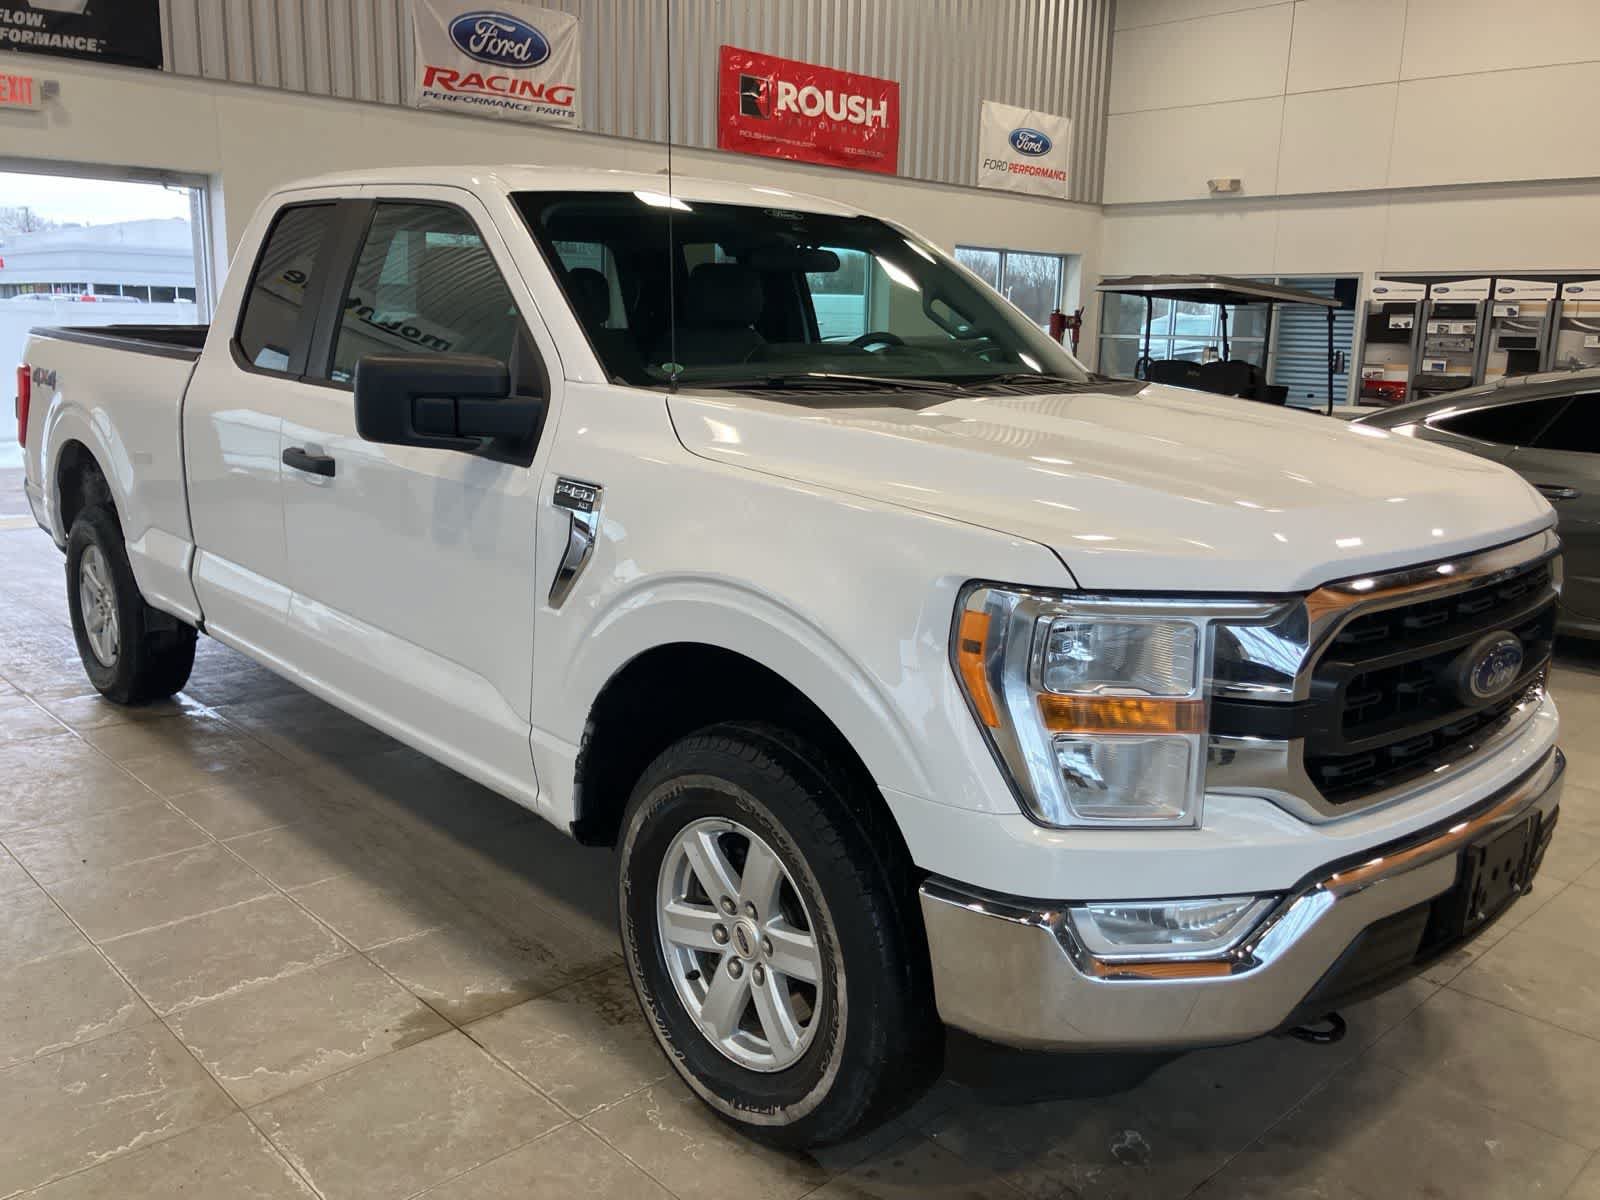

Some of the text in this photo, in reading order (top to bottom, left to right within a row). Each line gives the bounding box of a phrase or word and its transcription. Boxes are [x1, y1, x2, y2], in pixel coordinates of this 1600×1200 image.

[469, 19, 531, 61] Ford
[0, 72, 33, 106] EXIT
[423, 65, 576, 107] RACING
[423, 90, 576, 118] PERFORMANCE PARTS
[777, 80, 888, 128] ROUSH
[1016, 131, 1042, 152] Ford
[983, 158, 1067, 181] FORD PERFORMANCE
